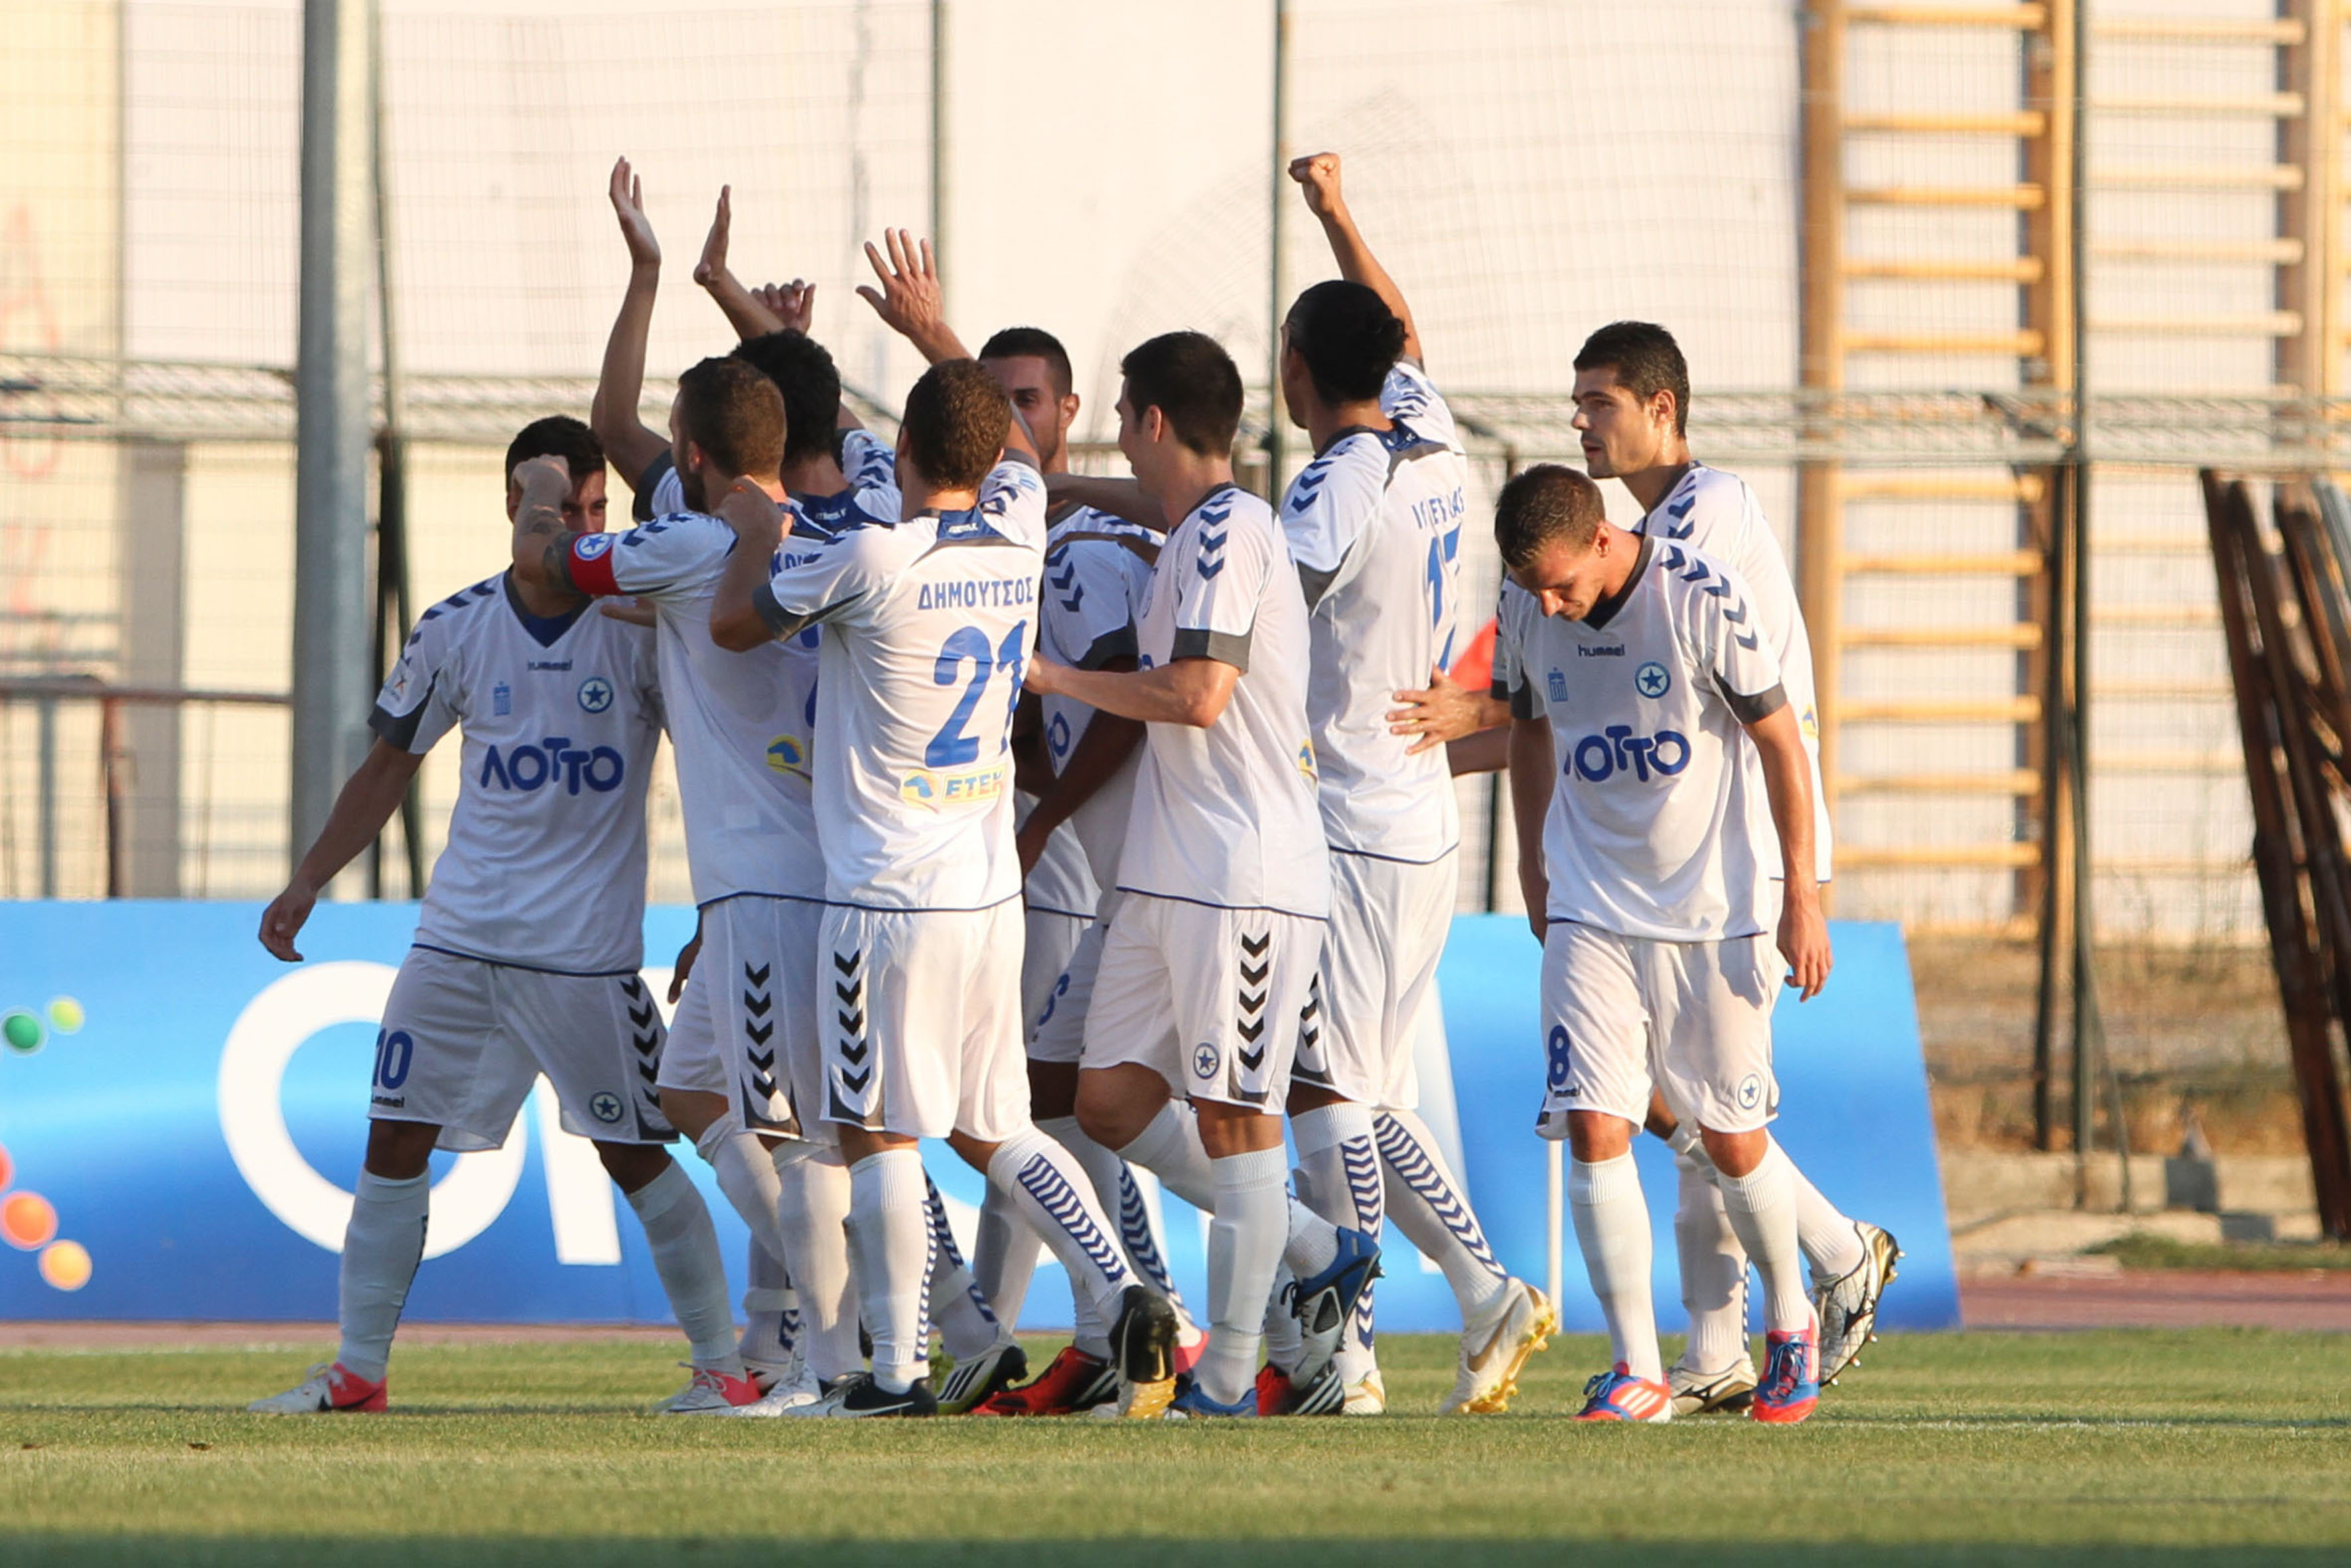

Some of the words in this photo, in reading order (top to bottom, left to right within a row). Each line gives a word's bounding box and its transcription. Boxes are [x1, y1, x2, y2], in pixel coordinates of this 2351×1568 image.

[918, 576, 1033, 610] ΔΗΜΟΥΤΣΟΣ
[1579, 644, 1625, 656] hummel
[925, 620, 1027, 768] 21
[372, 1027, 413, 1090] 10
[1549, 1025, 1571, 1086] 8
